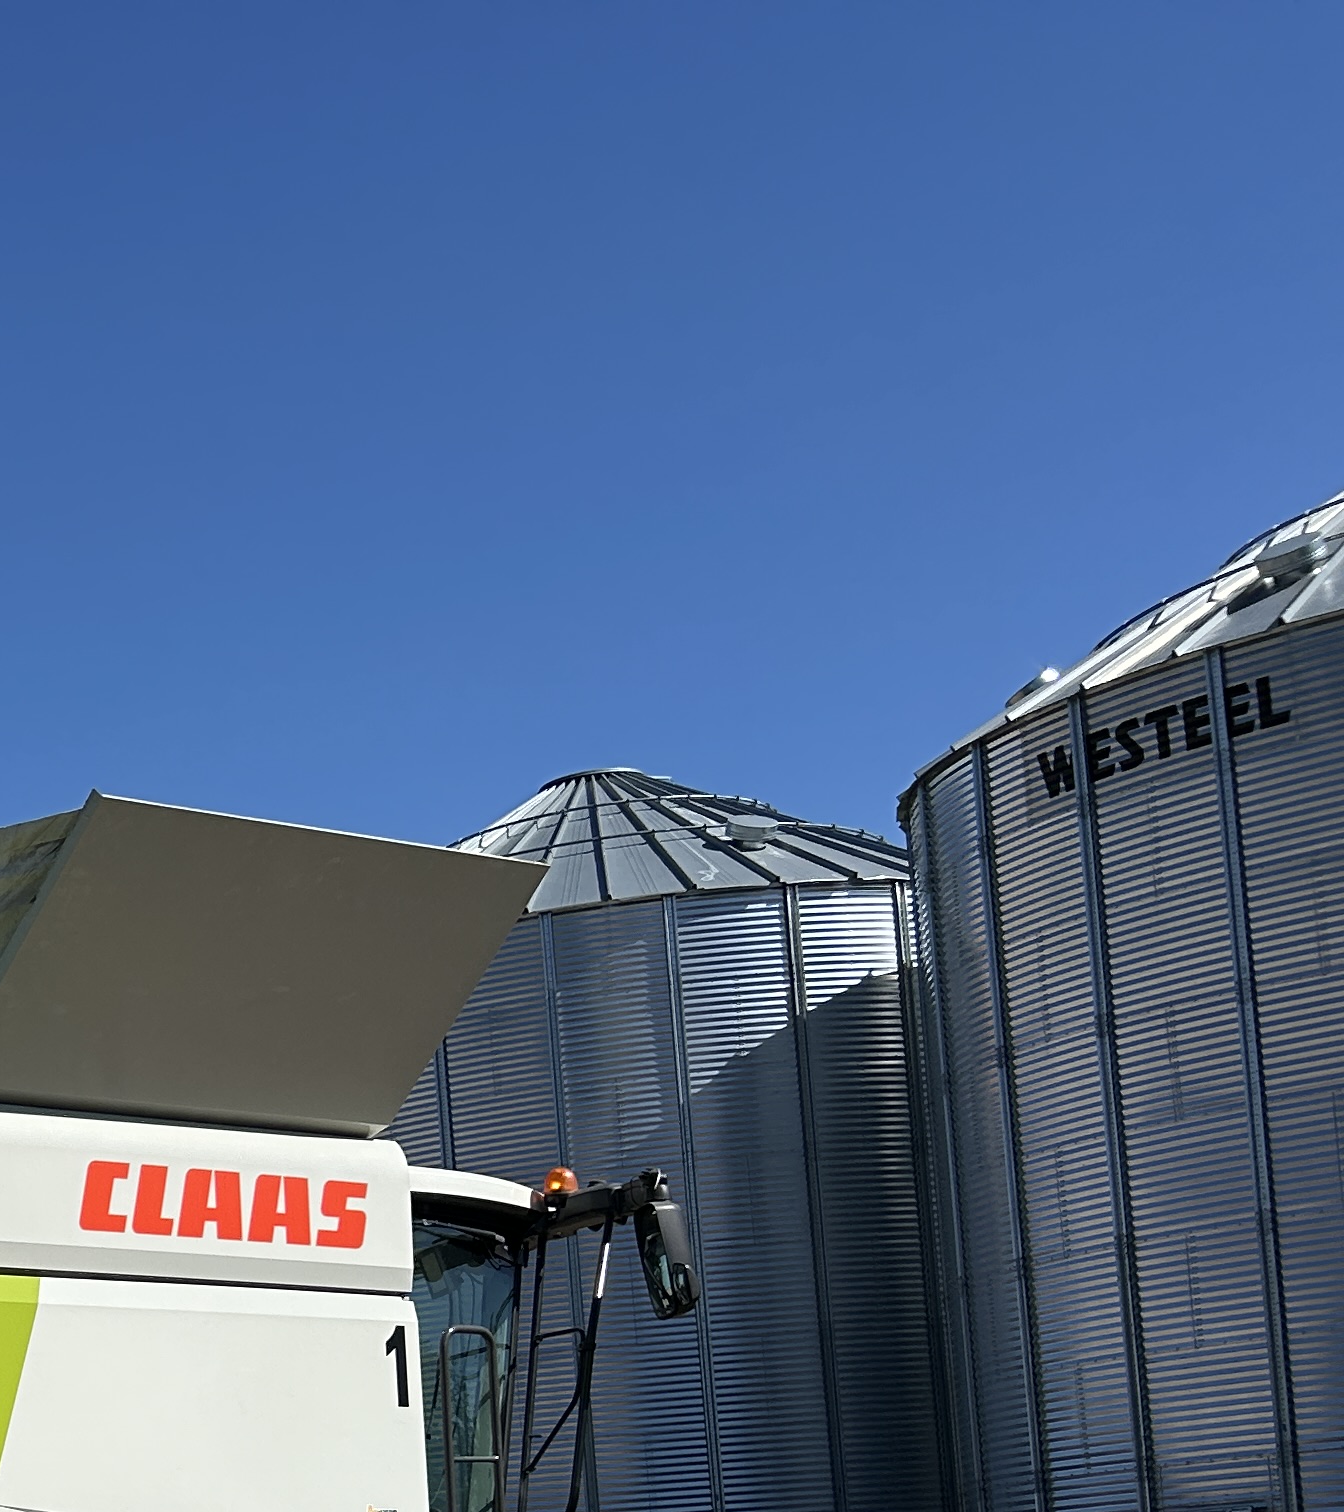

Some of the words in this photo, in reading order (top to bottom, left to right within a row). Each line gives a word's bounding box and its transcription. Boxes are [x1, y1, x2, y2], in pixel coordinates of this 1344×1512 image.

[1037, 675, 1291, 798] WESTEEL
[79, 1160, 368, 1250] CLAAS
[385, 1325, 410, 1408] 1
